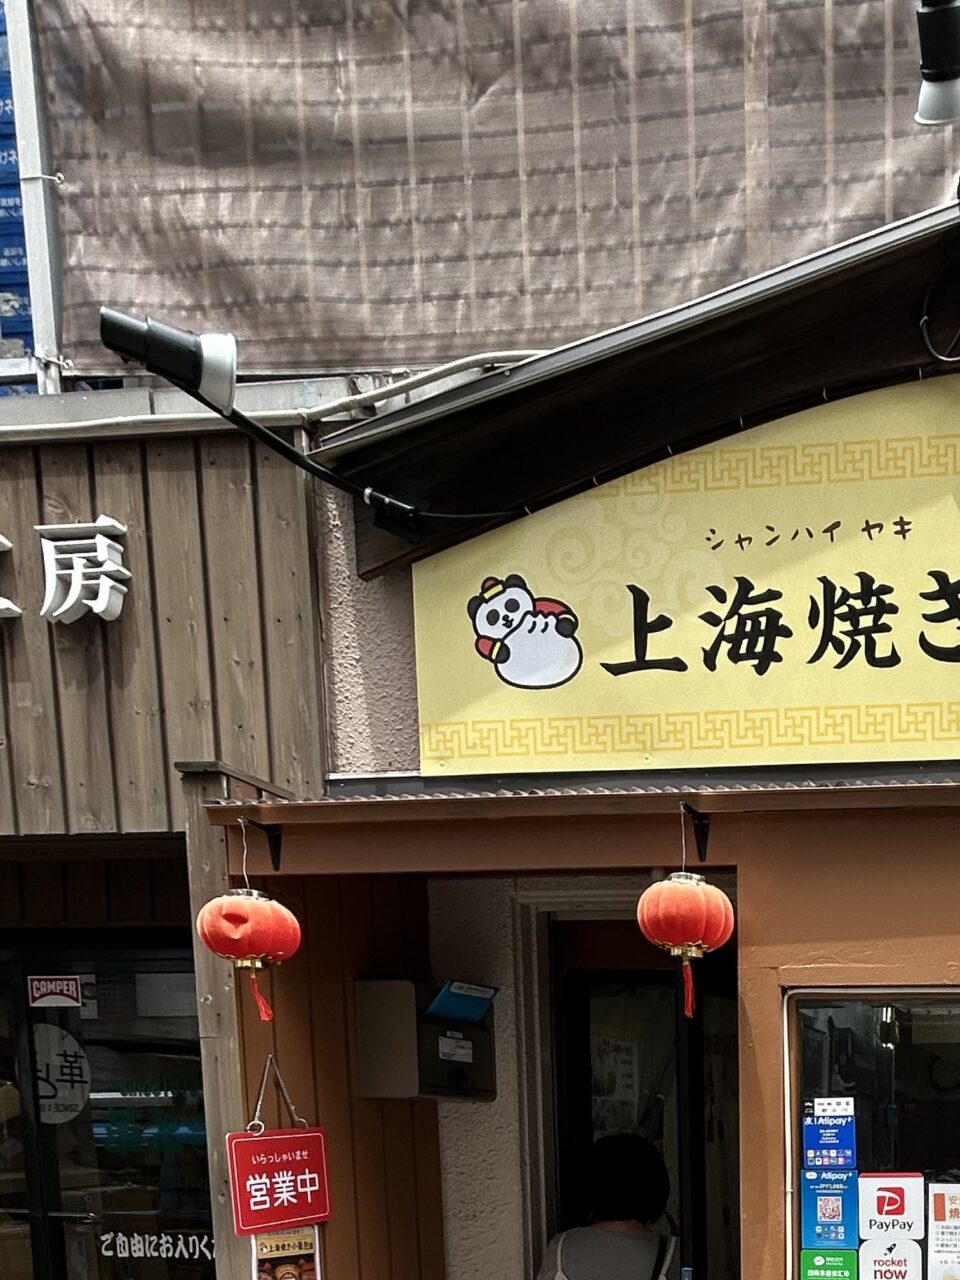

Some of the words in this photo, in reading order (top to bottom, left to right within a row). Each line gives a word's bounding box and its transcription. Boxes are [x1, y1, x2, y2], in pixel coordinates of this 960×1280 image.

[704, 520, 842, 552] シャンハイ
[860, 515, 913, 541] ヤキ
[0, 513, 132, 625] 房
[32, 978, 78, 999] CAMPER
[251, 1150, 310, 1165] いらっしゃいませ
[246, 1168, 320, 1211] 営業中
[869, 1219, 914, 1232] PayPay
[100, 1231, 215, 1260] ご自由にお入りく
[874, 1257, 908, 1267] rocket
[874, 1269, 908, 1280] now
